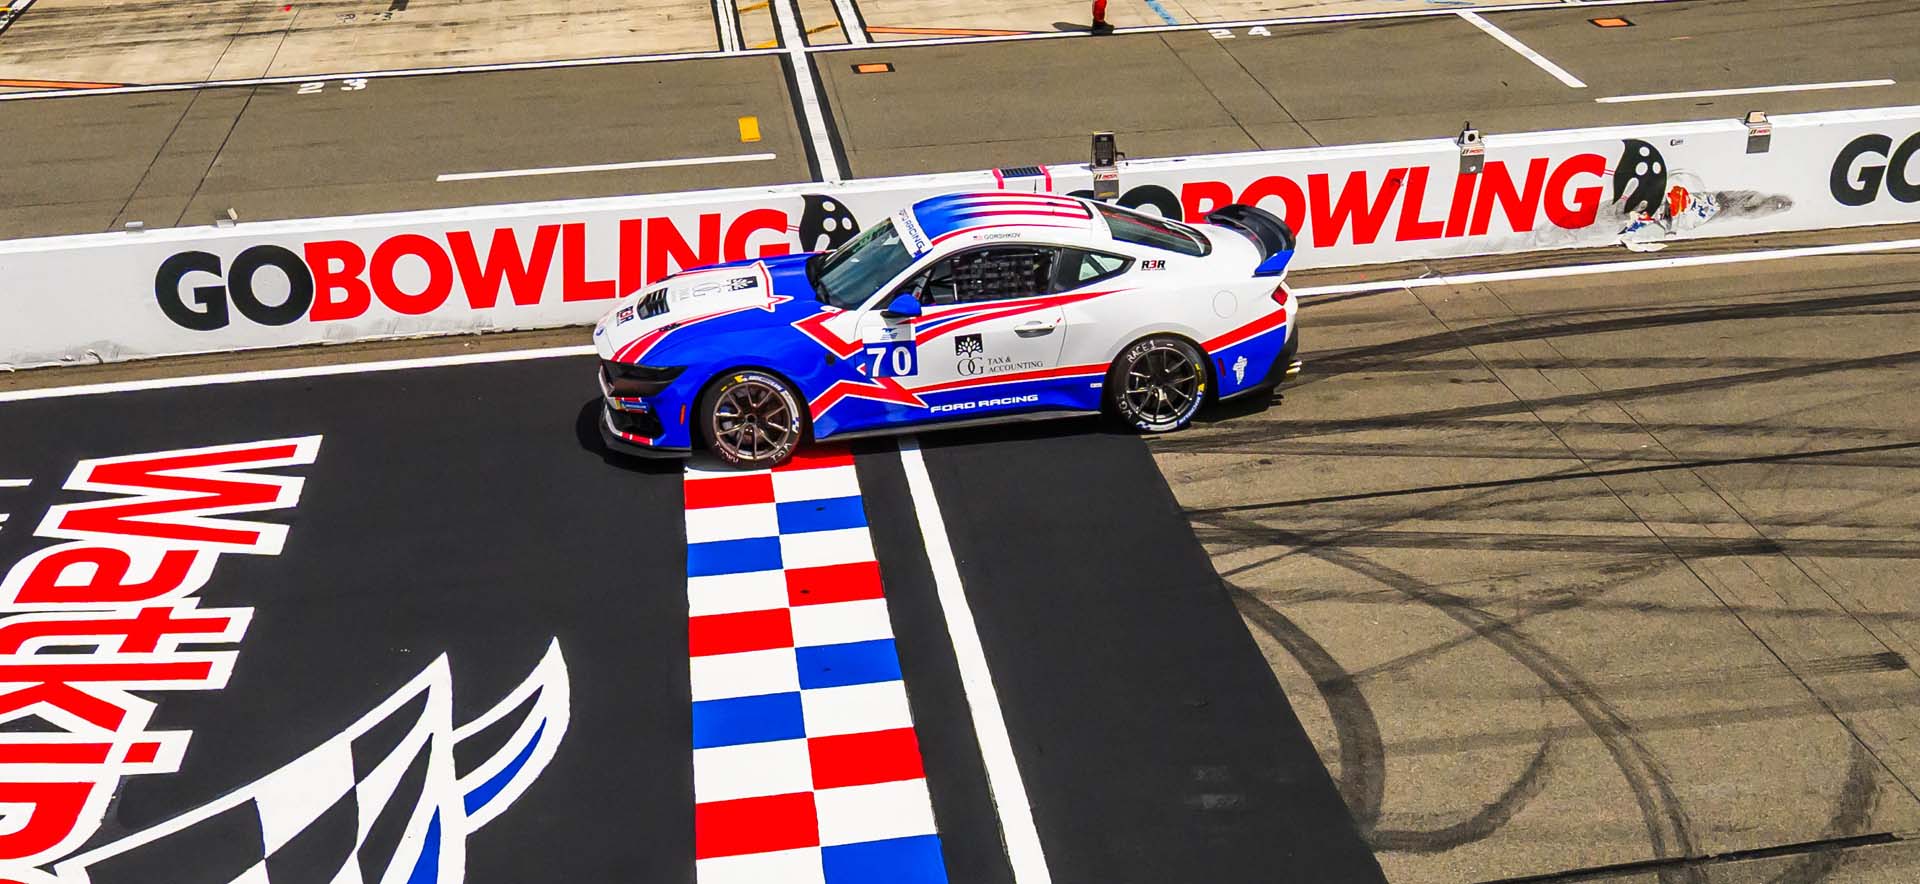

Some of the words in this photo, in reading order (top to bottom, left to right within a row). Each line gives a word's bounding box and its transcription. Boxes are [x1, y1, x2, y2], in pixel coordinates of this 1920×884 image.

[1141, 260, 1166, 269] R3R
[1127, 342, 1149, 362] RACE
[866, 346, 912, 377] 70
[988, 357, 1004, 365] TAX
[990, 361, 1044, 373] ACCOUNTING
[930, 402, 976, 413] FORD
[979, 394, 1038, 407] RACING
